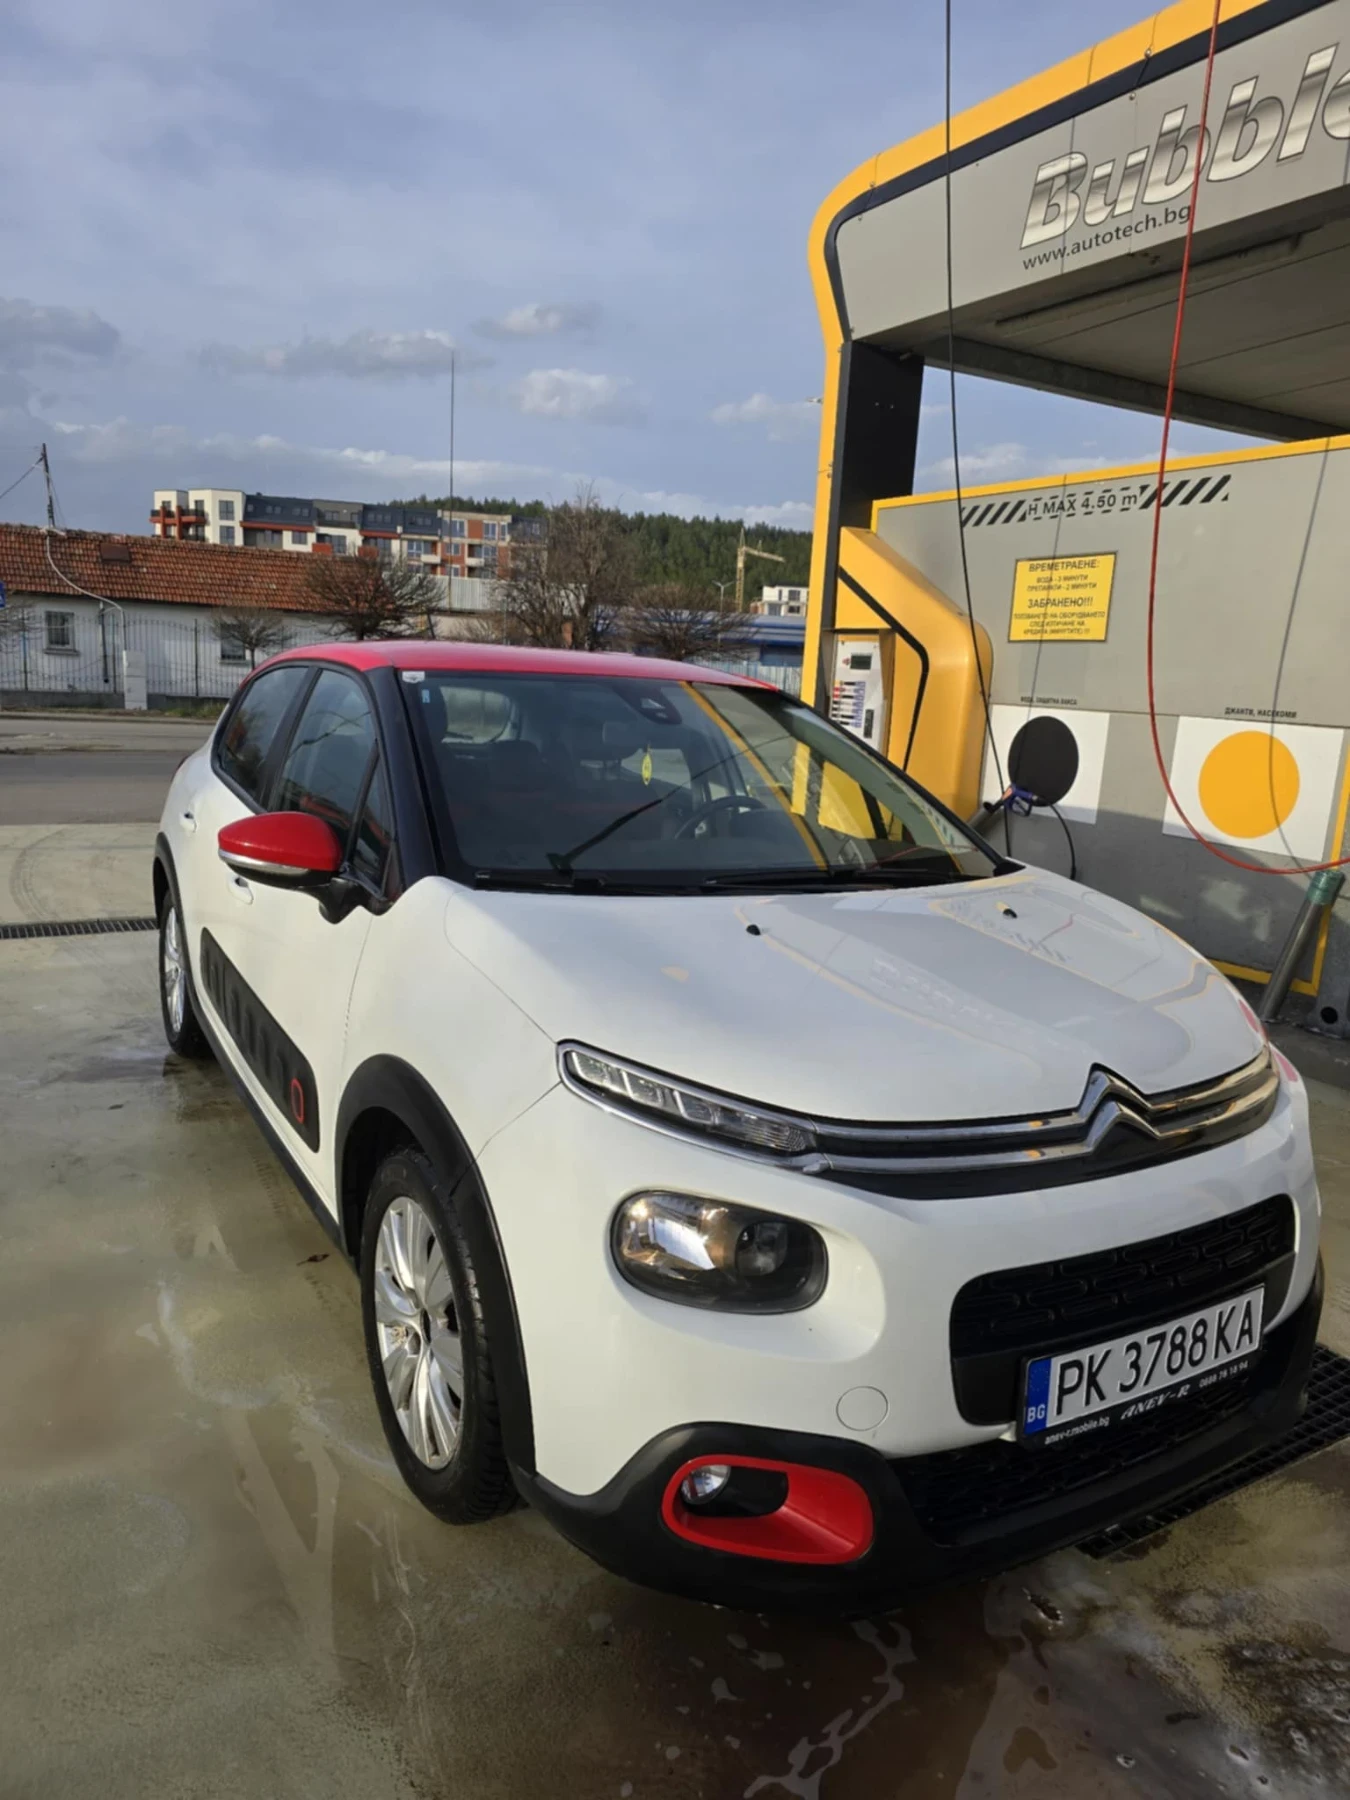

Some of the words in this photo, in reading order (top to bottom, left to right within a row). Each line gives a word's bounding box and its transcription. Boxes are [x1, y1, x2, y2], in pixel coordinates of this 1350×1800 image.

[1022, 204, 1193, 271] www.autotech.bg
[1028, 502, 1038, 516] H
[1043, 498, 1076, 514] MAX
[1081, 494, 1117, 509] 4.50
[1122, 494, 1138, 505] m
[1029, 559, 1101, 572] ВРЕМЕТРАЕНЕ:
[1028, 597, 1093, 609] ЗАБРАНЕНО!!!
[1117, 1317, 1208, 1393] 3788
[1027, 1403, 1046, 1423] BG
